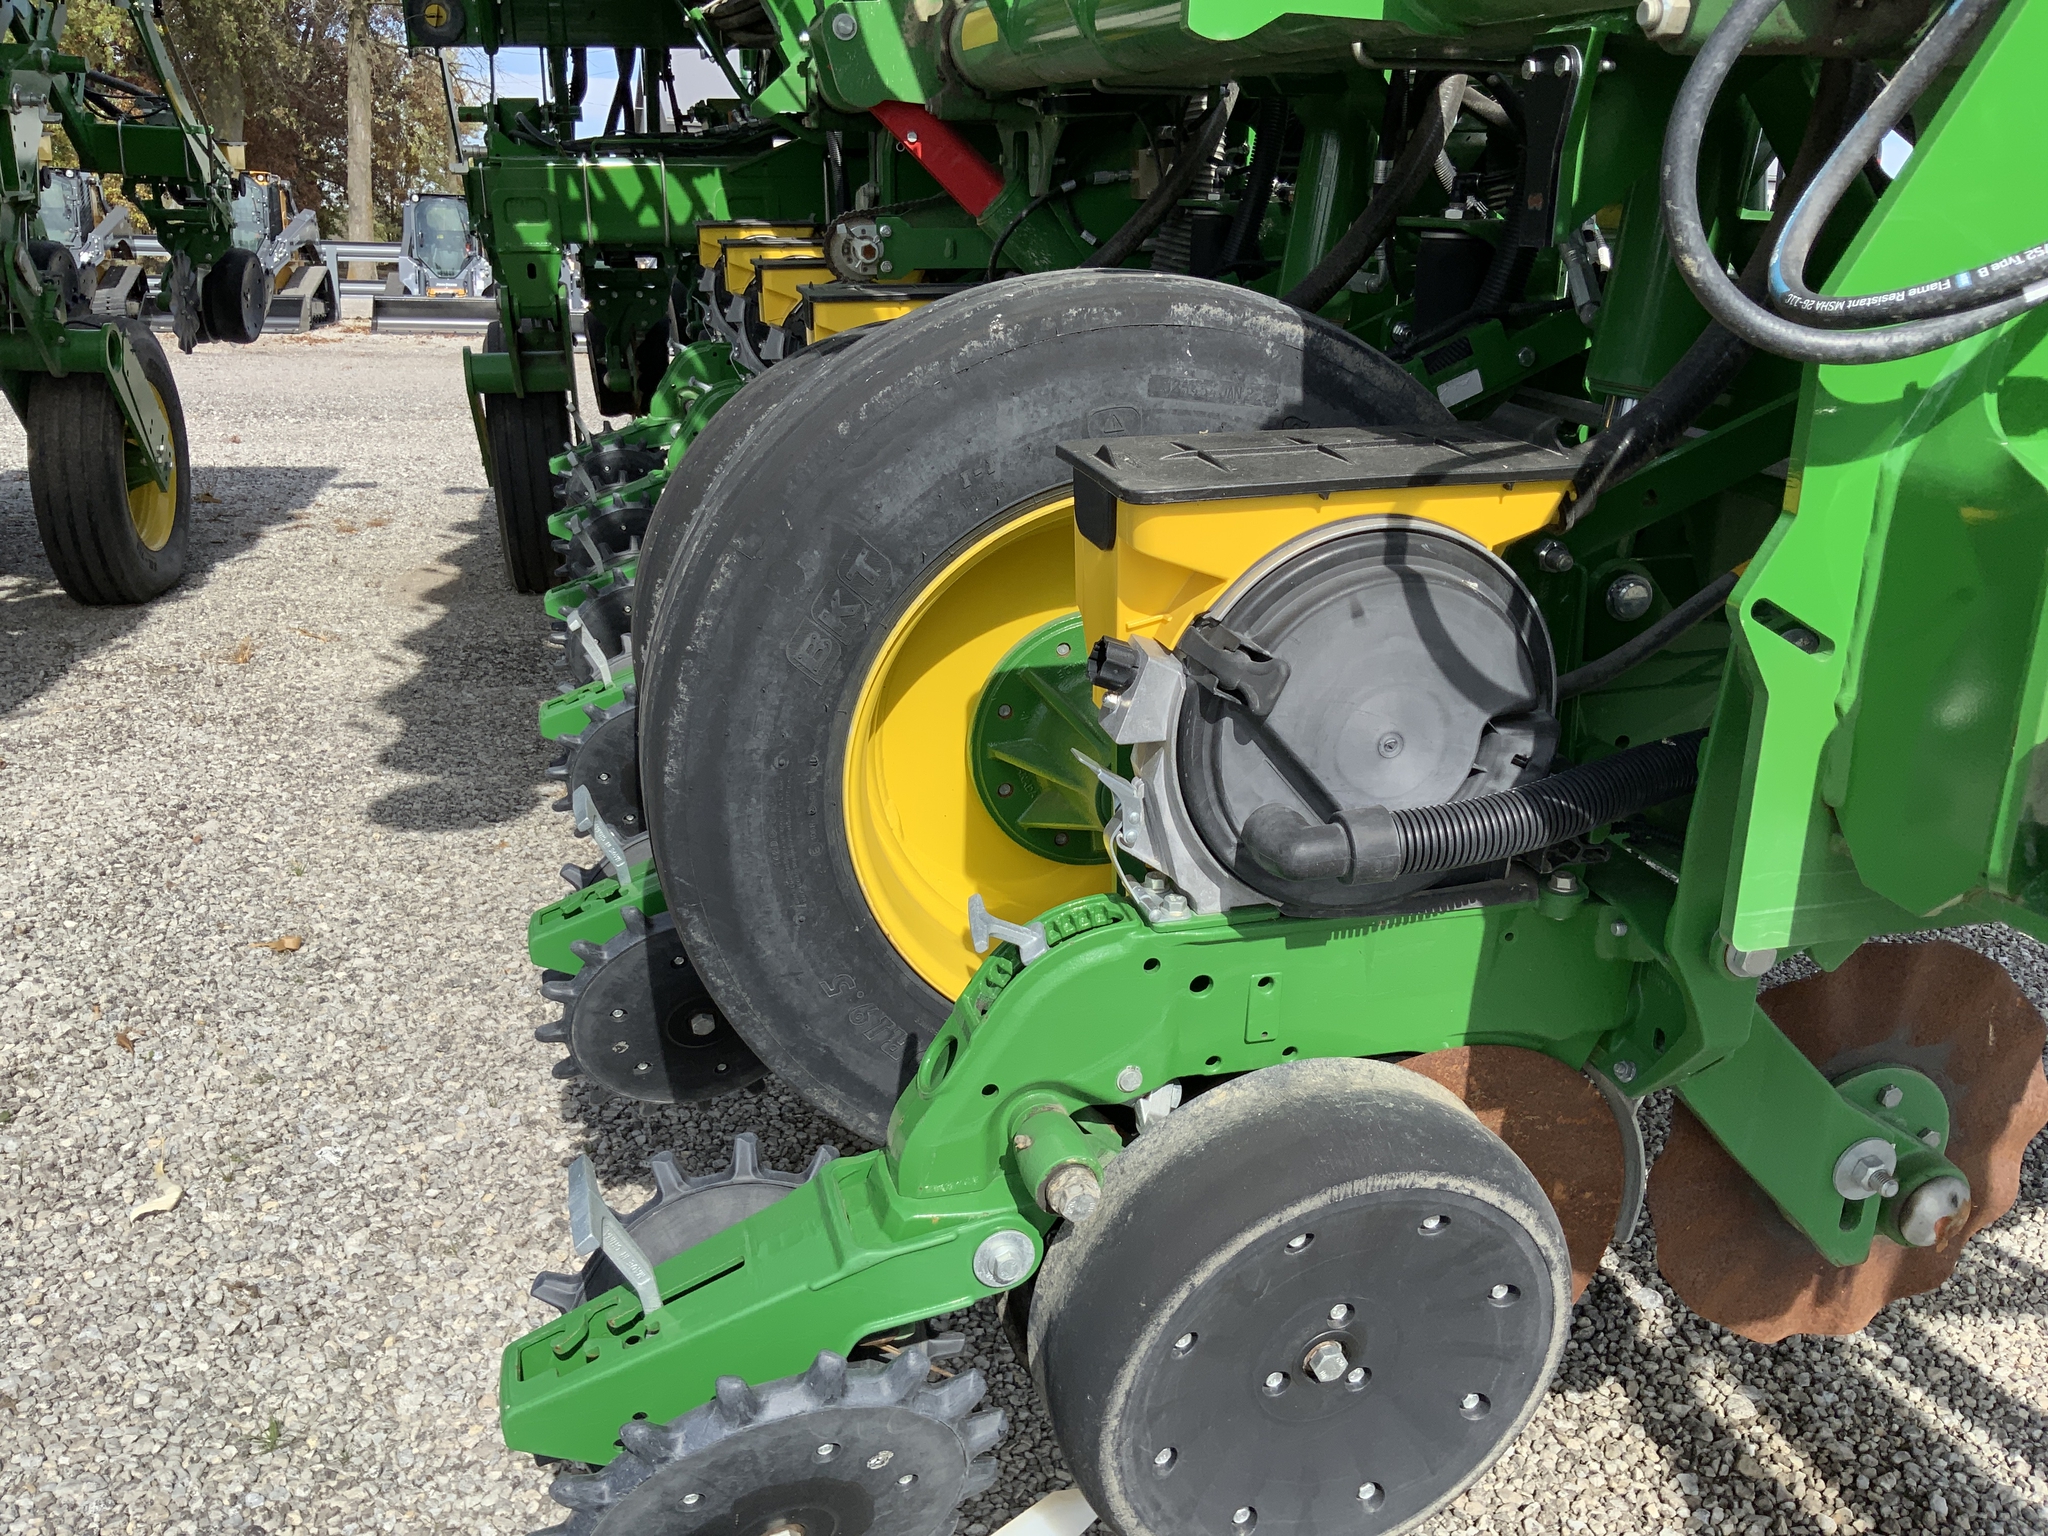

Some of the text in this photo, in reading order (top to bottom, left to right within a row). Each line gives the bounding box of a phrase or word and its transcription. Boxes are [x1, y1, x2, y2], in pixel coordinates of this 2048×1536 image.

[1977, 266, 1990, 278] B
[1991, 254, 2025, 272] Type
[1908, 279, 1952, 296] Flame
[1815, 300, 1846, 311] MSHA
[1847, 290, 1905, 309] Resistant
[793, 549, 878, 676] BKT
[819, 973, 909, 1061] R19.5
